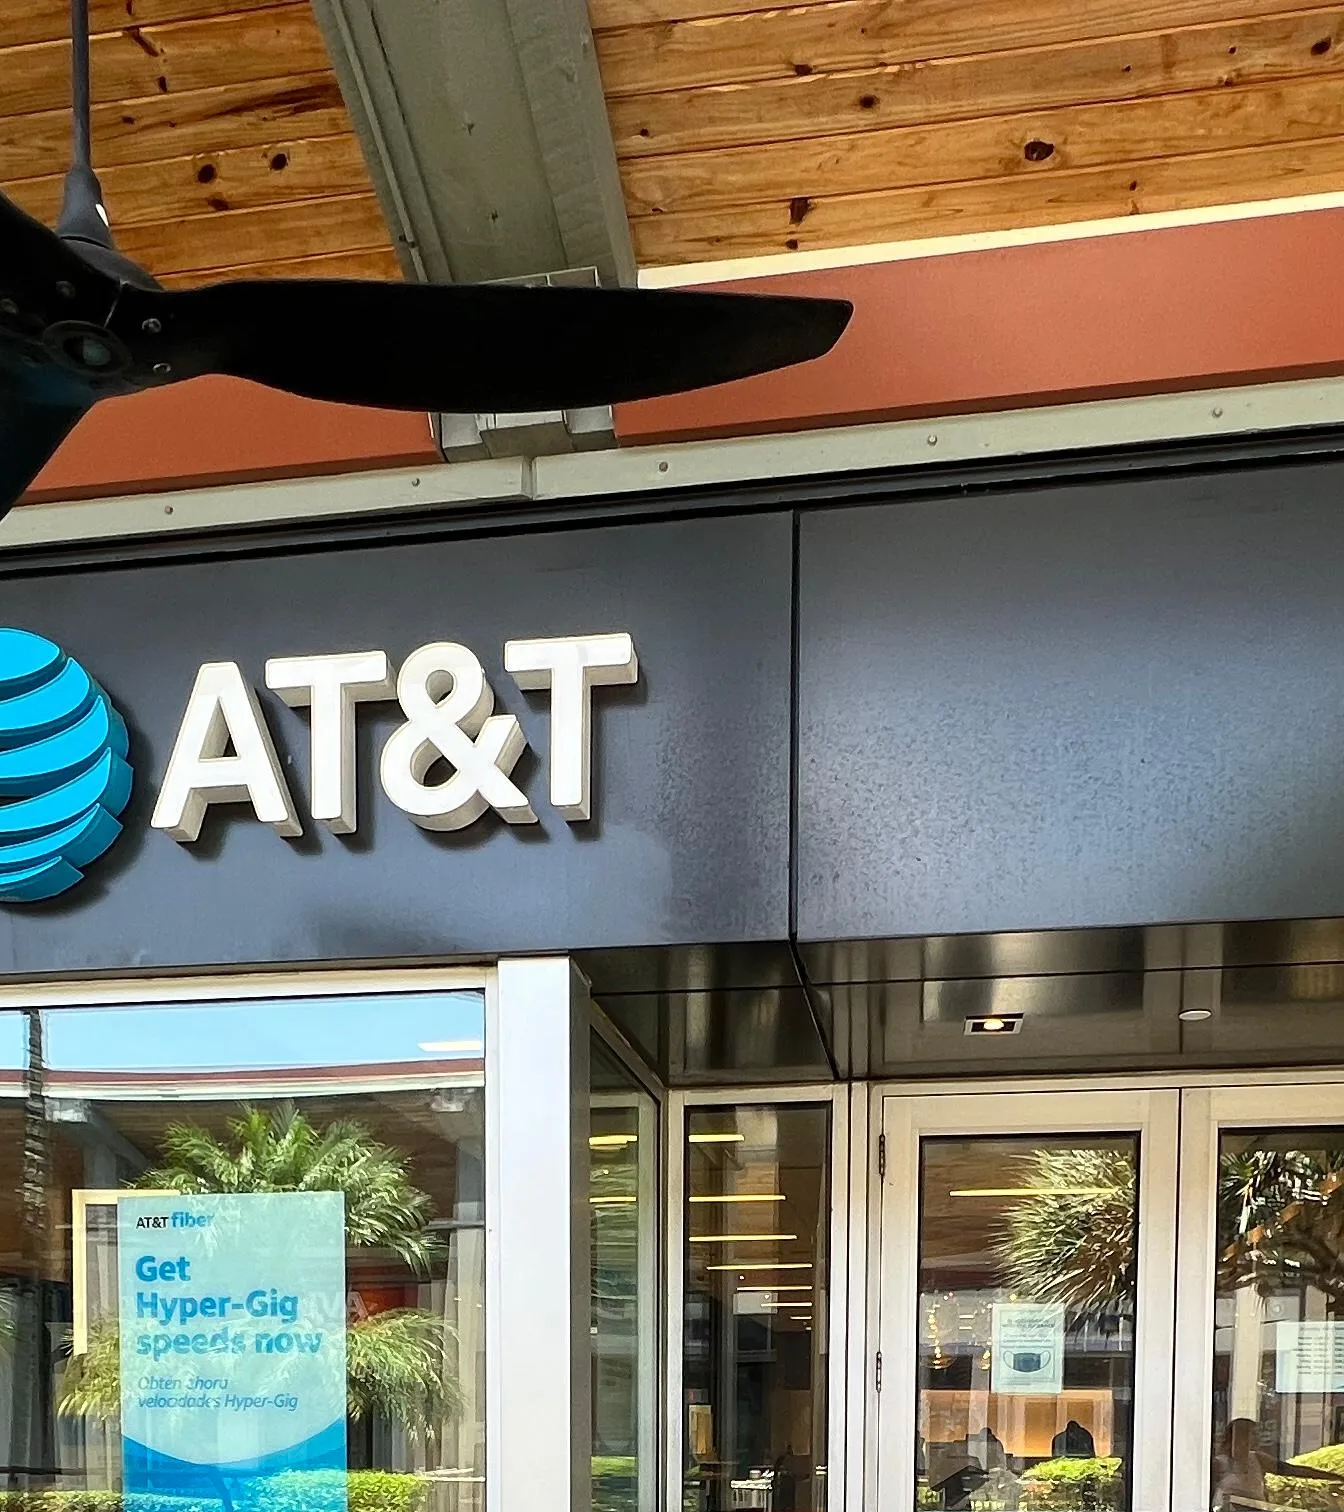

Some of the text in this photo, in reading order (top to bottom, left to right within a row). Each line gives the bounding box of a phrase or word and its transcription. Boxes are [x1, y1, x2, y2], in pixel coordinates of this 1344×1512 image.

[150, 633, 636, 838] AT&T
[136, 1211, 214, 1229] AT&T fiber
[135, 1255, 191, 1282] Get
[136, 1288, 299, 1326] Hyper-Gig
[136, 1326, 323, 1362] speeds now
[225, 1393, 299, 1412] Hyper-Gig
